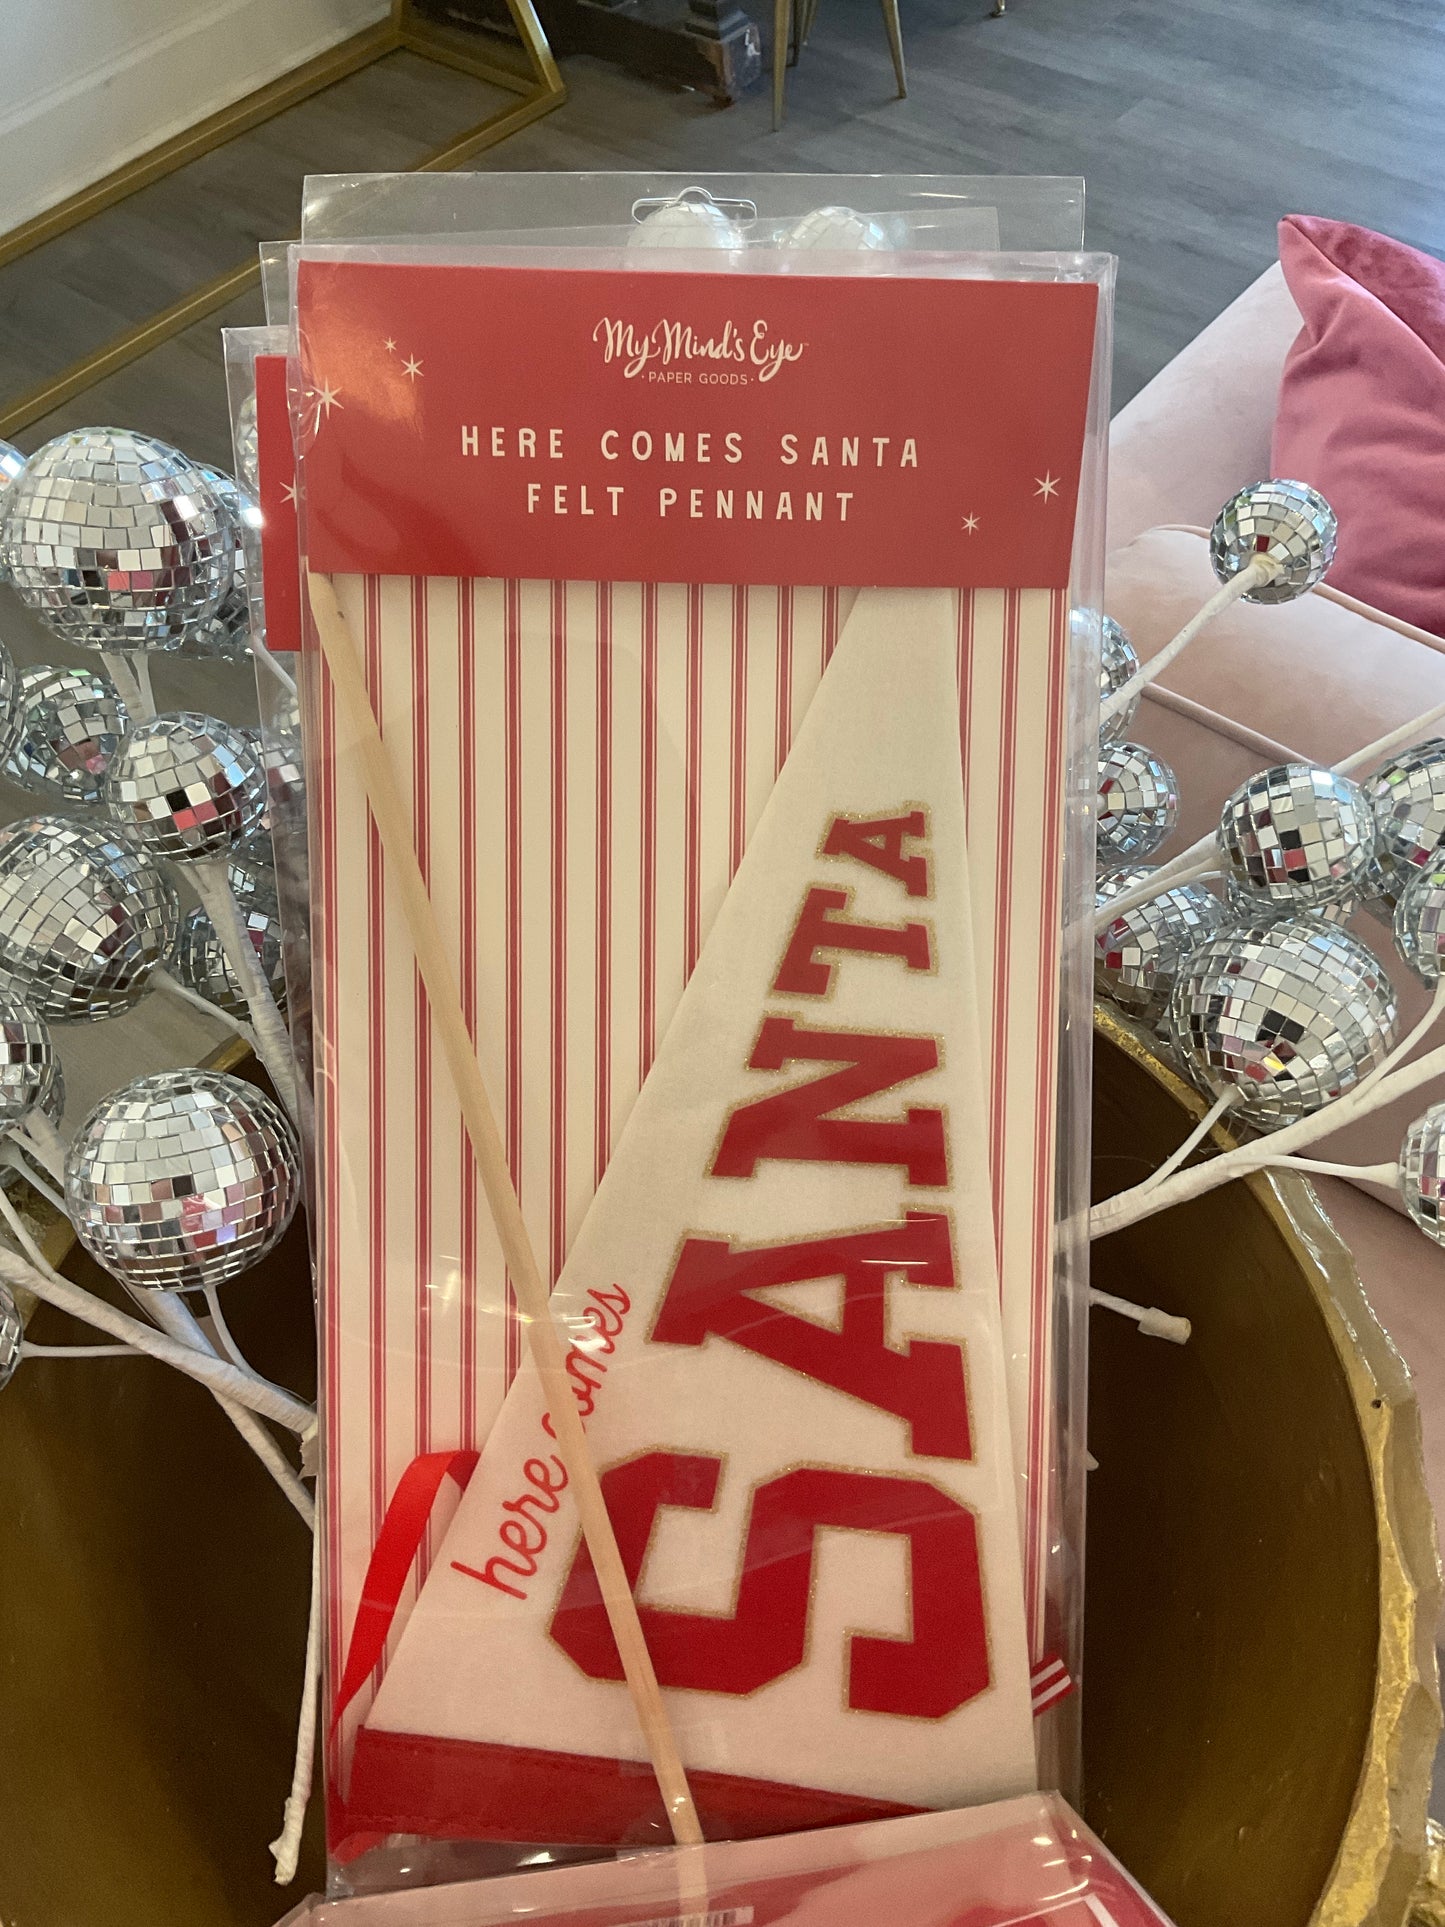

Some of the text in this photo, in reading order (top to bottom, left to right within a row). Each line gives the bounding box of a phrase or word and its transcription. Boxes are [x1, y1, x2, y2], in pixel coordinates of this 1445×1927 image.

[593, 317, 803, 382] My Mind's Eye
[648, 371, 748, 386] PAPER GOODS
[461, 425, 919, 468] HERE COMES SANTA
[527, 483, 853, 522] FELT PENNANT
[546, 799, 996, 1721] SANTA
[450, 1453, 569, 1600] here
